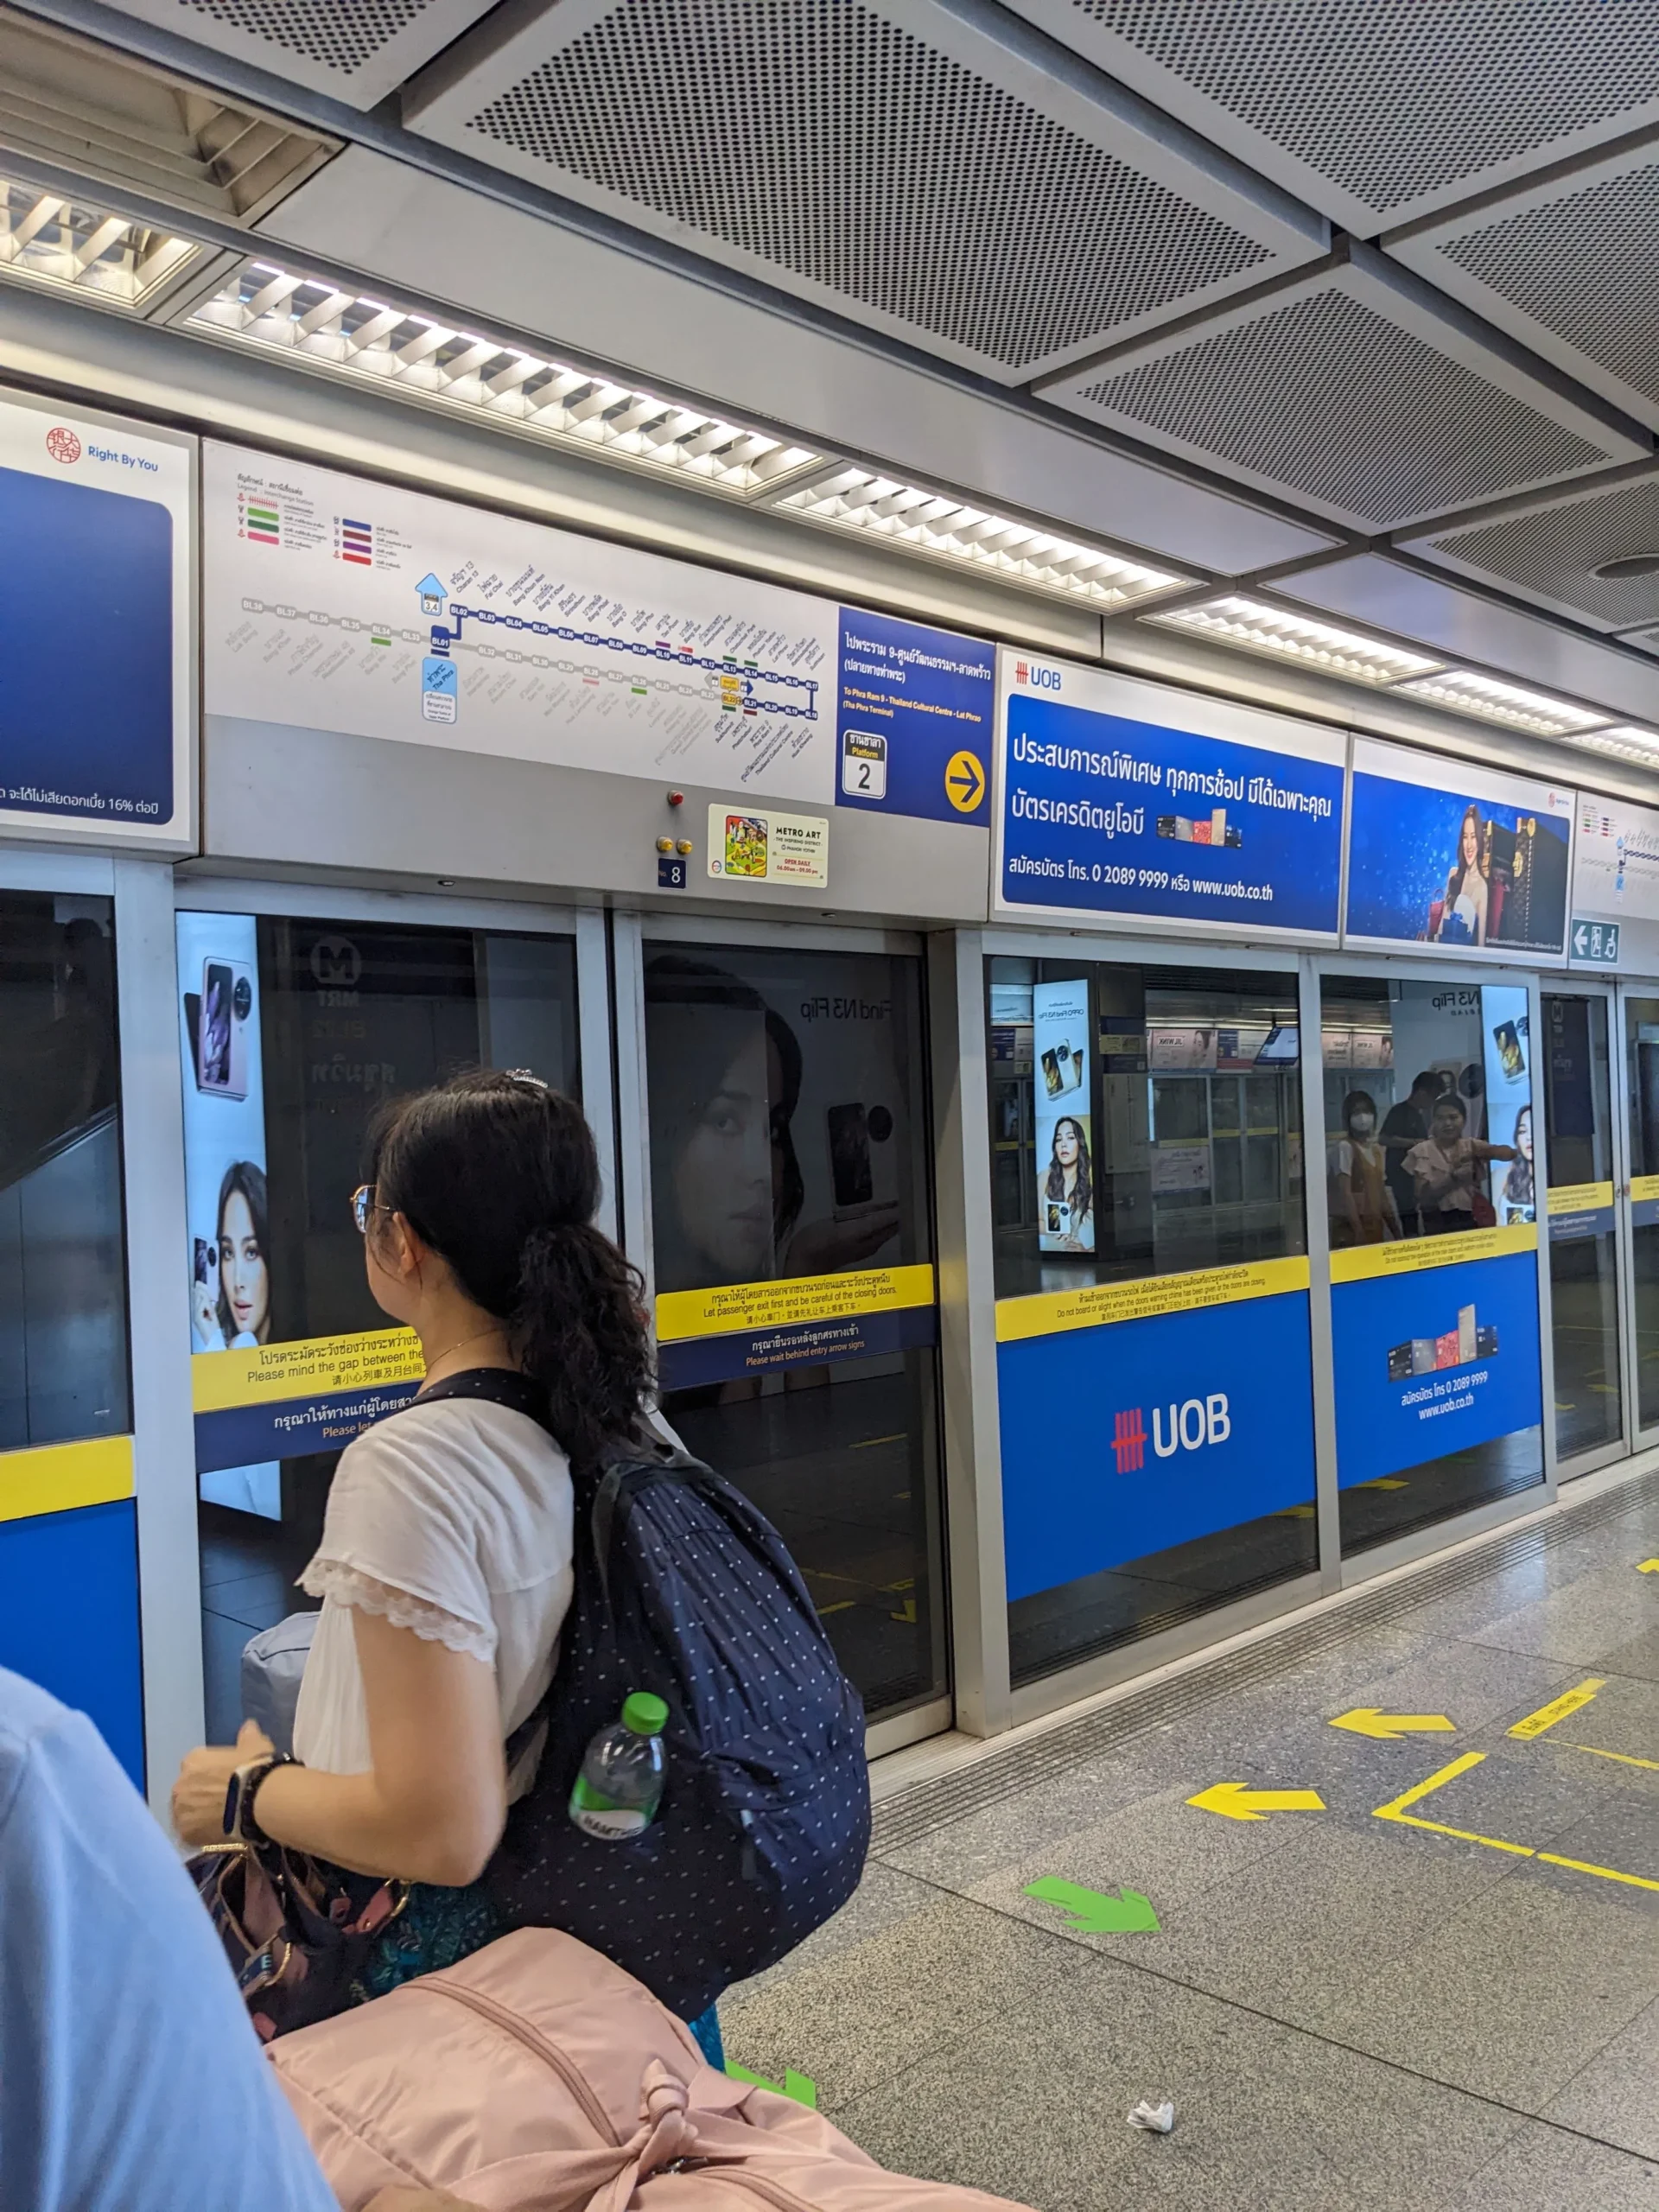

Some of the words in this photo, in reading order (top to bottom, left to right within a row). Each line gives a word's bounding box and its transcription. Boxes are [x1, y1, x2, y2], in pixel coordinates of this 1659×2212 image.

[88, 446, 118, 463] Right
[122, 454, 136, 467] By
[137, 458, 158, 472] You
[450, 606, 467, 616] BL02
[479, 612, 496, 622] BL03
[505, 618, 522, 628] BL04
[532, 623, 549, 632] BL05
[583, 634, 599, 644] BL07
[431, 637, 448, 647] BL01
[845, 632, 887, 656] ไปพระราม
[679, 655, 692, 664] BL11
[701, 659, 715, 669] BL12
[844, 658, 906, 683] (ปลายทางท่าพระ)
[744, 668, 758, 677] BL14
[1031, 666, 1061, 690] UOB
[805, 681, 817, 690] BL17
[843, 701, 855, 709] (Tha
[856, 702, 868, 712] Phra
[869, 706, 893, 718] Terminal)
[844, 687, 851, 696] To
[852, 689, 866, 698] Phra
[867, 691, 880, 701] Ram
[889, 696, 912, 709] Thailand
[913, 701, 934, 713] Cultural
[935, 705, 952, 716] Centre
[957, 710, 965, 719] Lat
[966, 712, 982, 722] Phrao
[849, 734, 881, 748] ชานชาลา
[852, 747, 878, 759] Platform
[858, 763, 870, 790] 2
[1014, 733, 1161, 785] ประสบการณ์พิเศษ
[1166, 767, 1244, 801] ทุกการช้อป
[1248, 777, 1332, 823] มีได้เฉพาะคุณ
[9, 786, 105, 810] จะได้ไม่เสียดอกเบี้ย
[108, 798, 133, 812] 16%
[136, 802, 158, 815] ต่อปี
[1012, 787, 1144, 839] บัตรเครดิตยูโอบี
[776, 827, 804, 837] METRO
[806, 830, 821, 839] ART
[671, 866, 681, 883] 8
[1009, 855, 1065, 878] สมัครบัตร
[1067, 860, 1089, 881] โทร.
[1092, 865, 1102, 882] 0
[1103, 867, 1135, 886] 2089
[1139, 869, 1169, 889] 9999
[1172, 874, 1190, 893] หรือ
[1192, 880, 1273, 901] www.uob.co.th
[703, 1308, 715, 1318] Let
[718, 1301, 754, 1318] passenger
[757, 1300, 769, 1310] exit
[771, 1299, 784, 1308] first
[785, 1297, 798, 1306] and
[800, 1295, 809, 1305] be
[810, 1292, 833, 1304] careful
[834, 1292, 842, 1300] of
[842, 1290, 853, 1300] the
[855, 1287, 877, 1301] closing
[878, 1285, 897, 1295] doors.
[1076, 1306, 1090, 1315] board
[1098, 1301, 1112, 1313] alight
[1113, 1300, 1125, 1309] when
[1135, 1296, 1149, 1306] doors
[1150, 1294, 1167, 1305] warning
[1205, 1287, 1217, 1296] given
[752, 1324, 859, 1354] กรุณายืนรอหลังลูกศรทางเข้า
[247, 1370, 284, 1382] Please
[289, 1363, 315, 1376] mind
[318, 1361, 335, 1373] the
[339, 1358, 359, 1373] gap
[363, 1351, 406, 1366] between
[410, 1349, 423, 1360] the
[746, 1354, 768, 1367] Please
[769, 1352, 784, 1363] wait
[785, 1348, 810, 1361] behind
[810, 1345, 828, 1357] entry
[829, 1343, 848, 1353] arrow
[849, 1340, 866, 1352] signs
[1402, 1388, 1433, 1407] สมัครบัตร
[1433, 1382, 1446, 1396] โทร
[1446, 1381, 1452, 1393] 0
[1452, 1376, 1471, 1393] 2089
[1471, 1370, 1488, 1387] 9999
[1418, 1392, 1474, 1421] www.uob.co.th
[323, 1424, 355, 1439] Please
[1153, 1393, 1231, 1458] UOB
